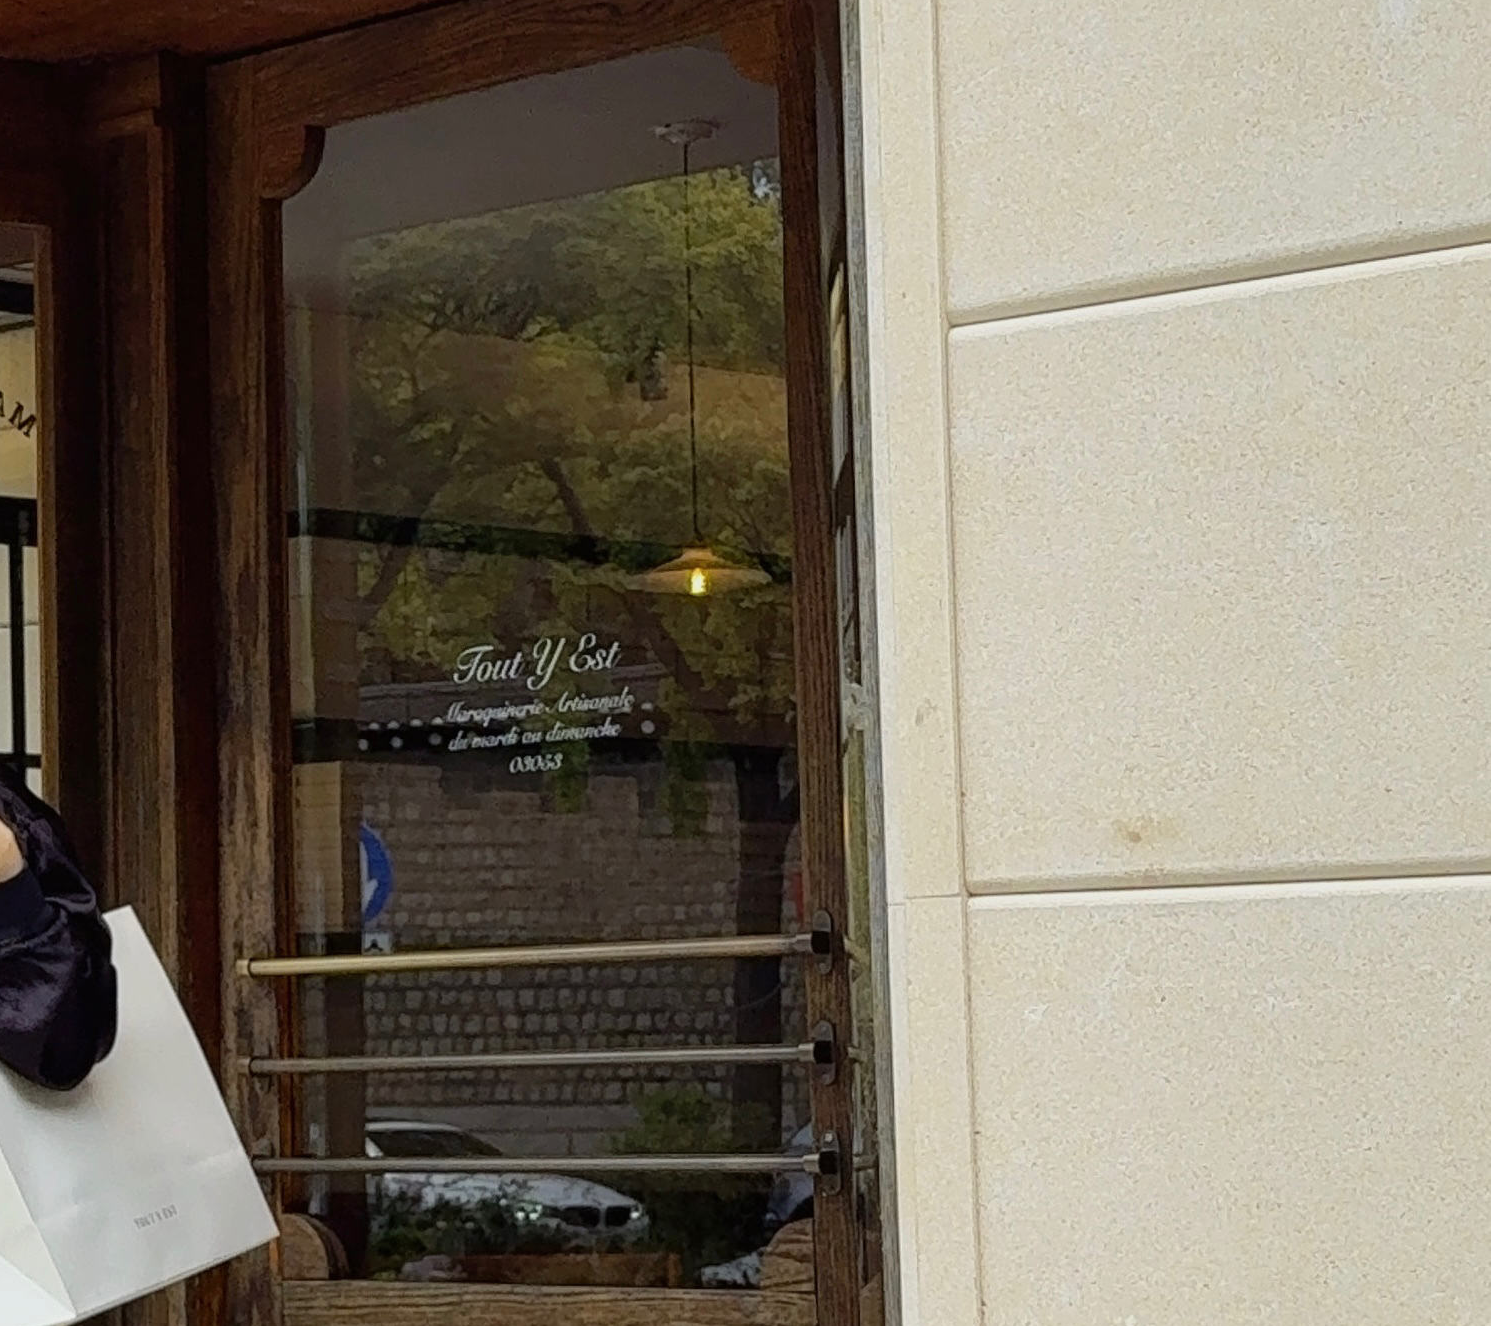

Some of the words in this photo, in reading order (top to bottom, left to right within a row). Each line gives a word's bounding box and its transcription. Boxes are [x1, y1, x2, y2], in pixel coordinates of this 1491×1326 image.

[453, 645, 523, 684] Tout
[526, 638, 566, 691] Y
[569, 633, 621, 673] Est
